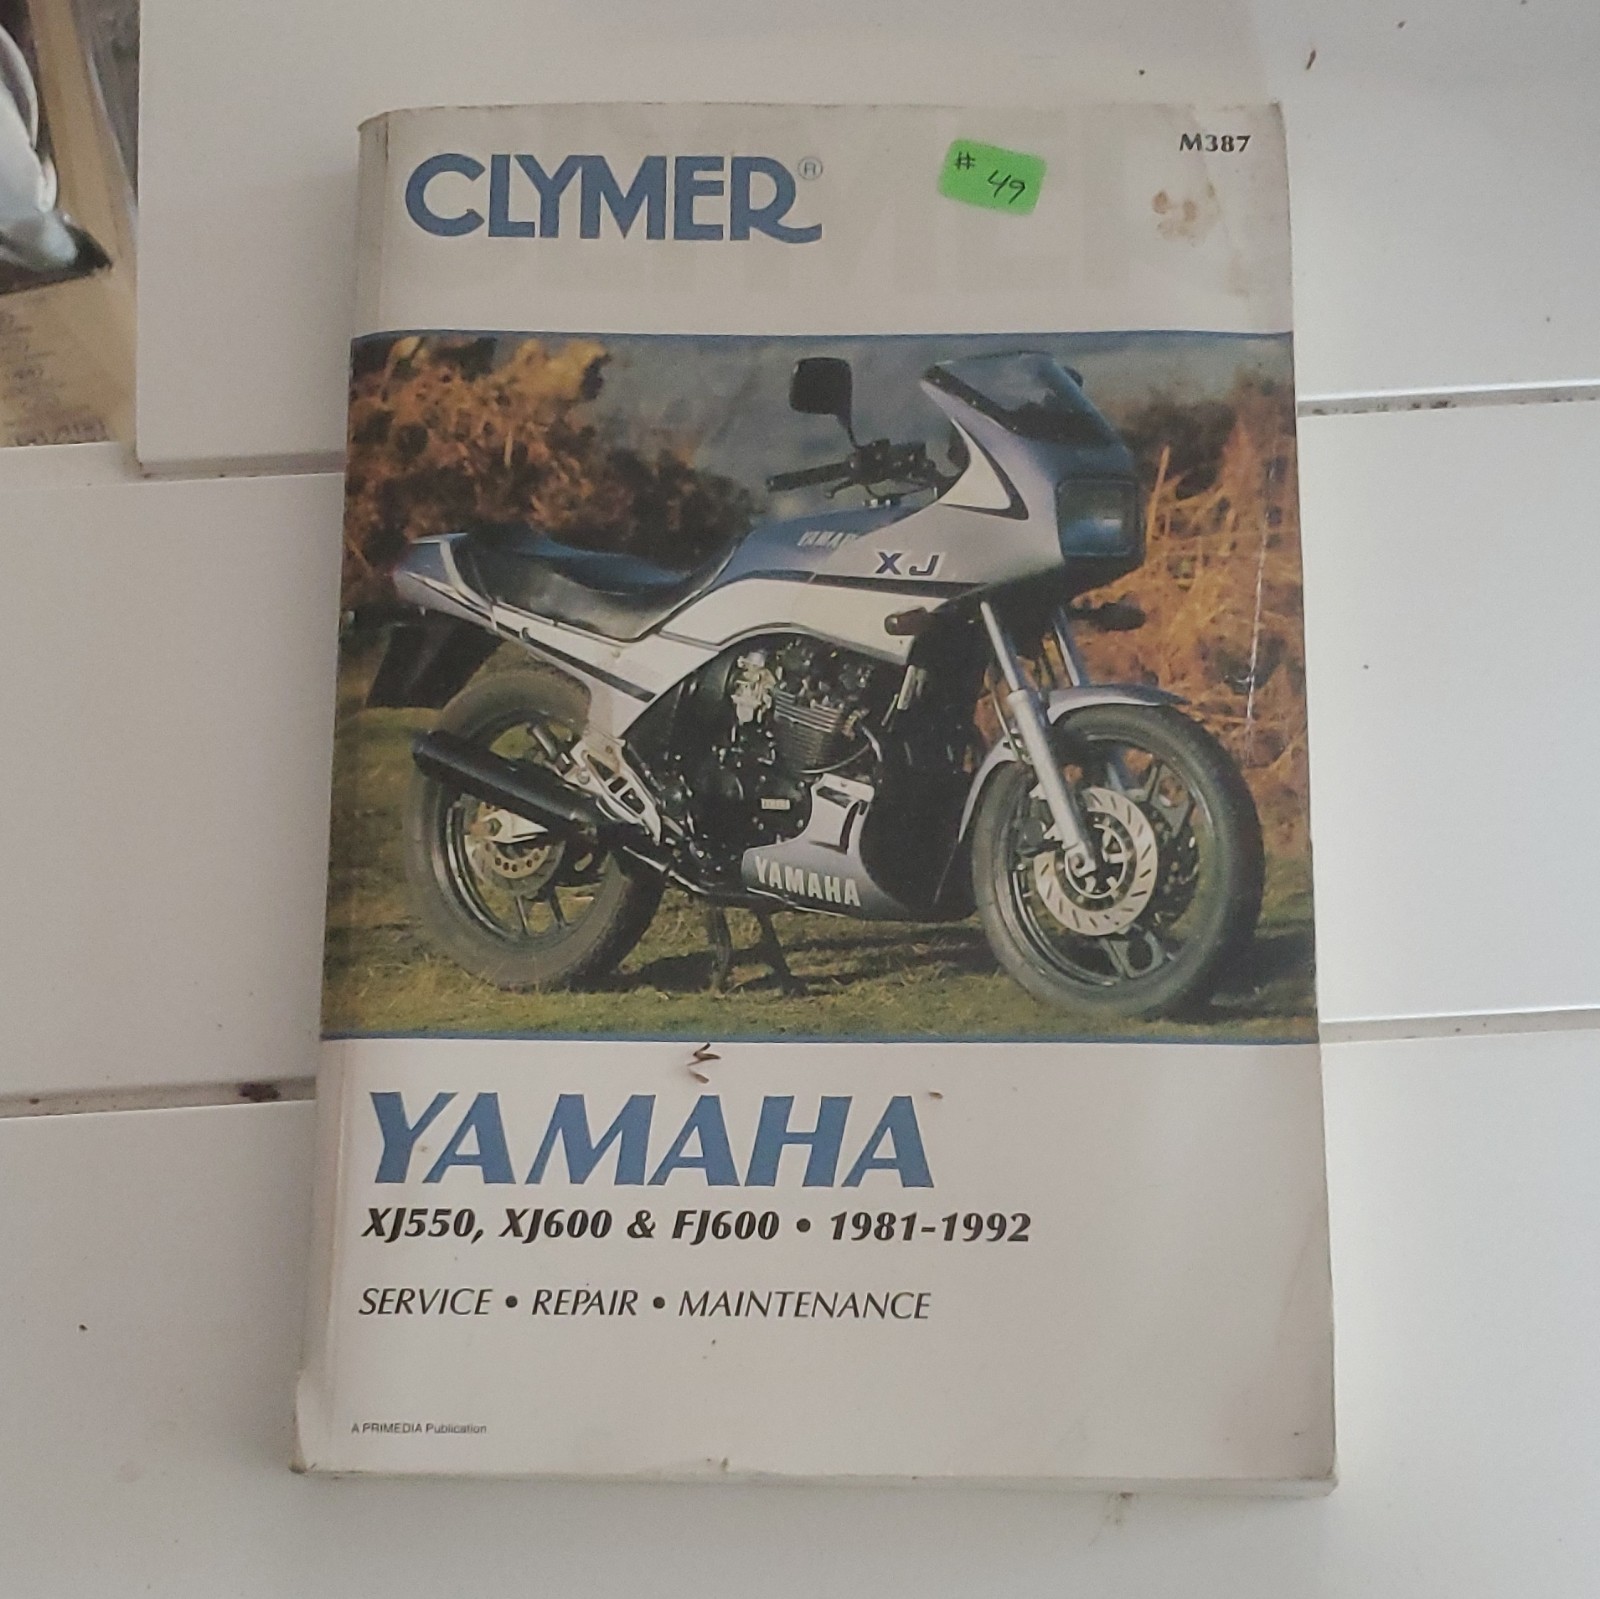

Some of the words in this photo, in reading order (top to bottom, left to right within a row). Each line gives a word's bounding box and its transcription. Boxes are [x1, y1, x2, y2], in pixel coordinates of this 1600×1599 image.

[1179, 132, 1252, 153] M387
[404, 153, 824, 244] CLYMER
[987, 169, 1026, 205] 49
[874, 551, 941, 577] XJ
[754, 855, 862, 907] YAMAHA
[368, 1091, 934, 1188] YAMAHA
[360, 1206, 484, 1245] XJ550,
[498, 1207, 613, 1245] XJ600
[626, 1209, 657, 1240] &
[671, 1209, 780, 1246] FJ600
[830, 1210, 1032, 1243] 1981-1992
[357, 1287, 493, 1316] SERVICE
[531, 1288, 639, 1317] REPAIR
[678, 1290, 932, 1320] MAINTENANCE
[351, 1423, 360, 1433] A
[362, 1422, 423, 1434] PRIMEDIA
[425, 1422, 487, 1434] Publication
